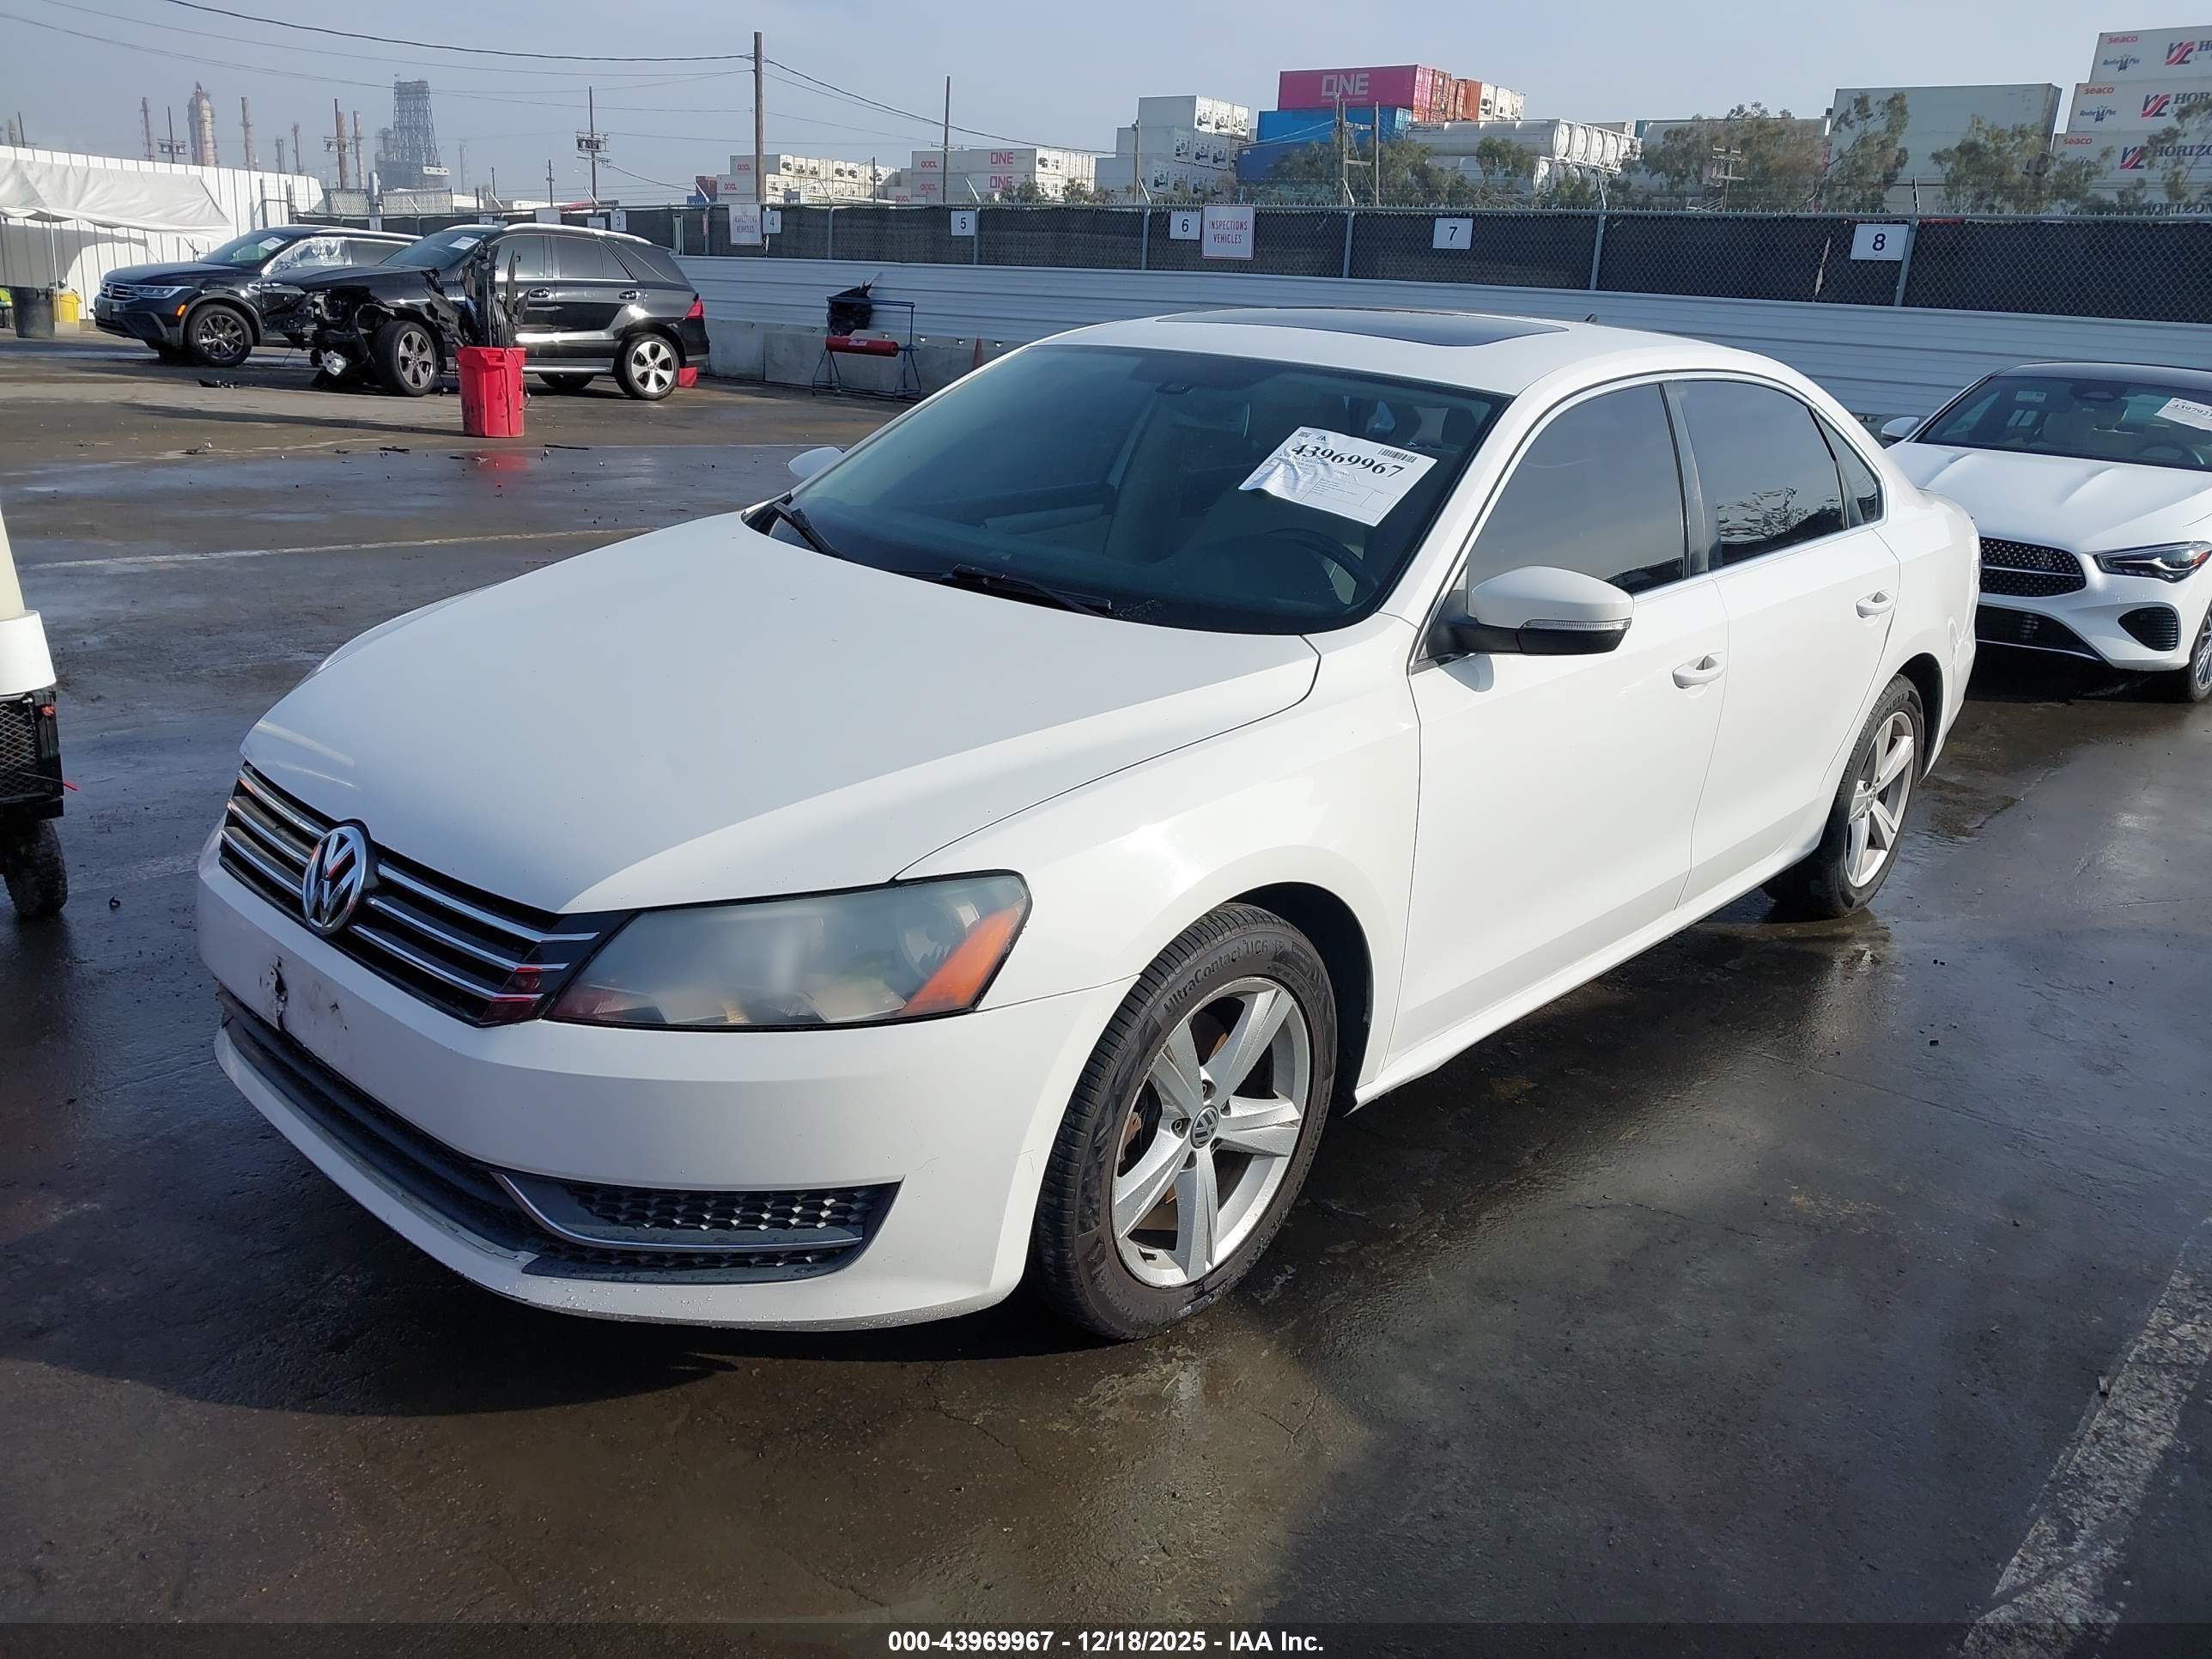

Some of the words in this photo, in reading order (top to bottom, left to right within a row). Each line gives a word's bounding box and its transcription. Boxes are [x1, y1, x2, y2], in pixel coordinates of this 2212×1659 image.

[1322, 73, 1370, 96] ONE
[2084, 86, 2115, 94] seaco
[990, 152, 1014, 165] ONE
[616, 216, 621, 227] 3
[769, 216, 775, 228] 4
[960, 217, 967, 229] 5
[1182, 218, 1189, 233] 6
[1208, 219, 1248, 231] INSPECTIONS
[1213, 234, 1243, 244] VEHICLES
[1449, 226, 1458, 241] 7
[1872, 233, 1887, 252] 8
[1291, 444, 1405, 477] 43969967
[1163, 946, 1243, 1013] UltraContact
